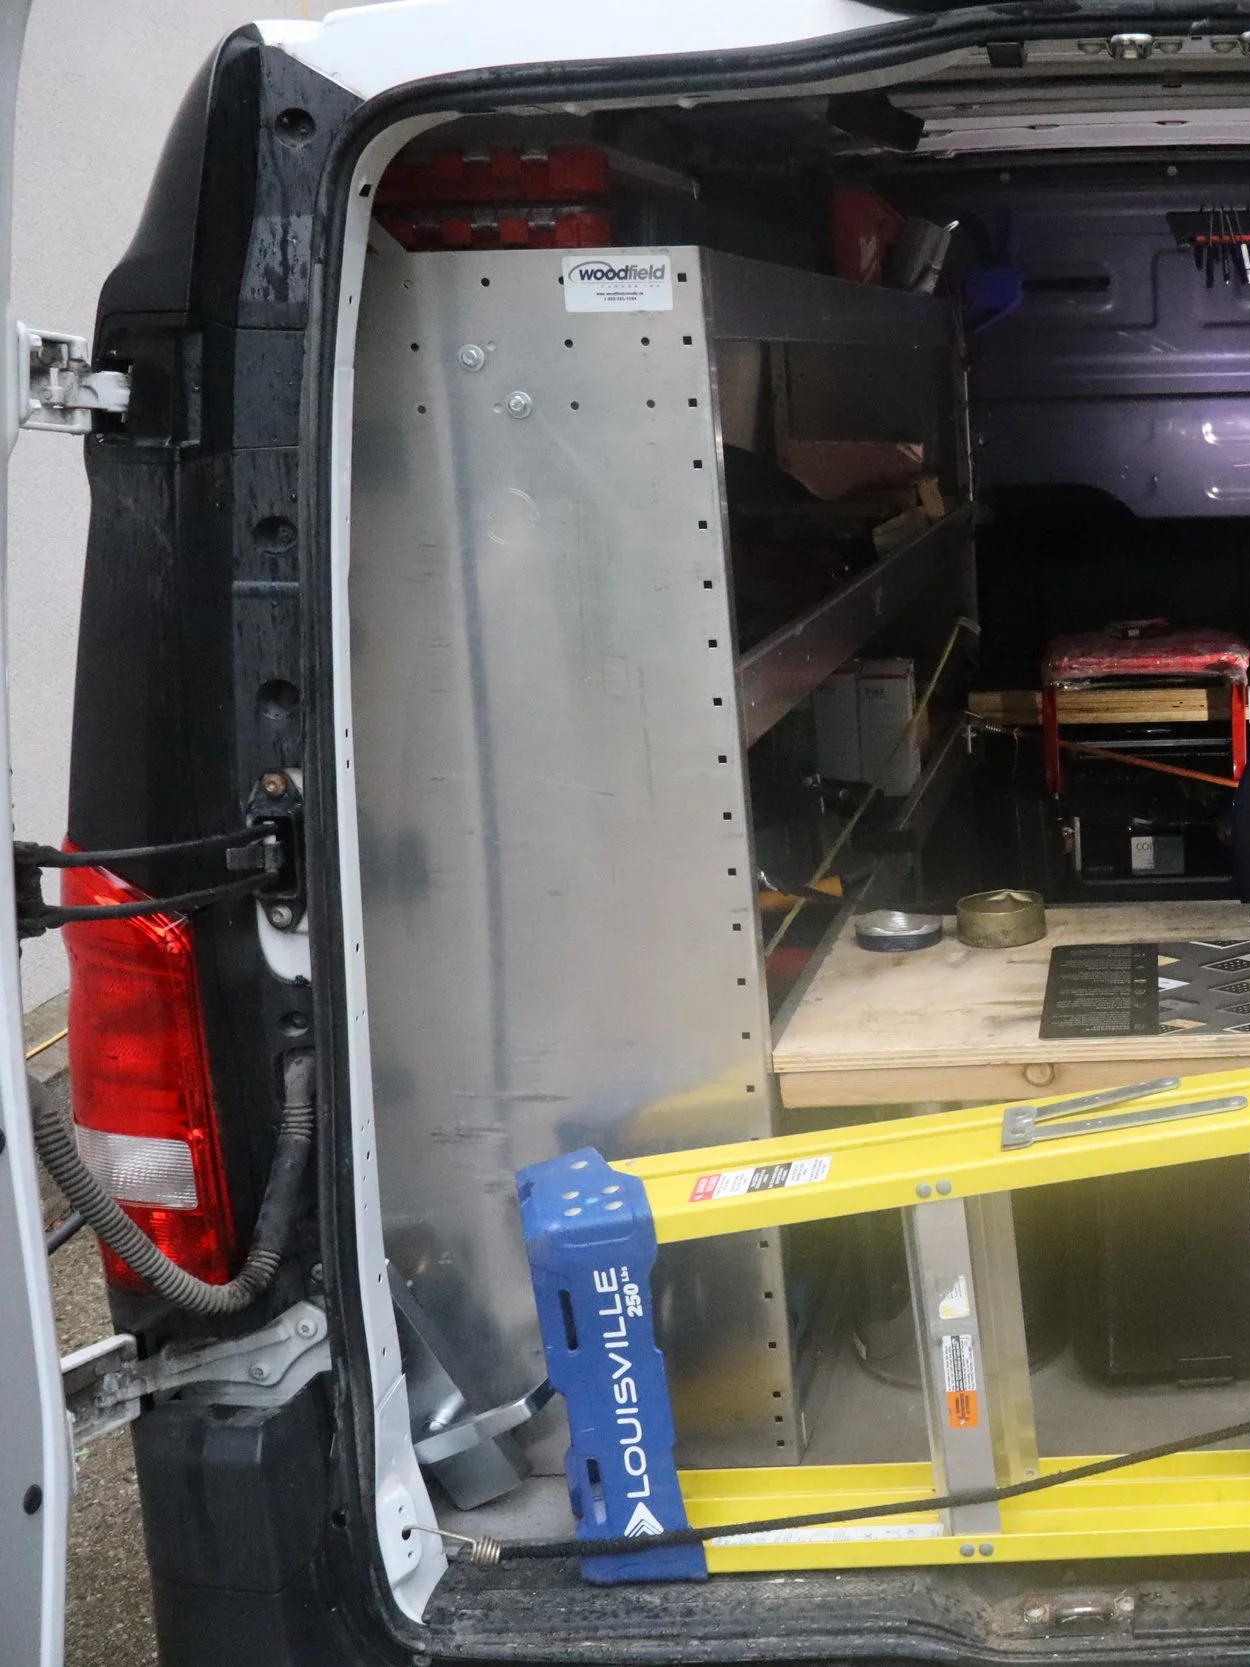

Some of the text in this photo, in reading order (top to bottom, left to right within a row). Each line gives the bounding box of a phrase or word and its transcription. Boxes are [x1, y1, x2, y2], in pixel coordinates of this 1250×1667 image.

[579, 264, 666, 281] woodfield
[620, 1266, 644, 1318] 250 Lbs
[593, 1267, 651, 1499] LOUISVILLE
